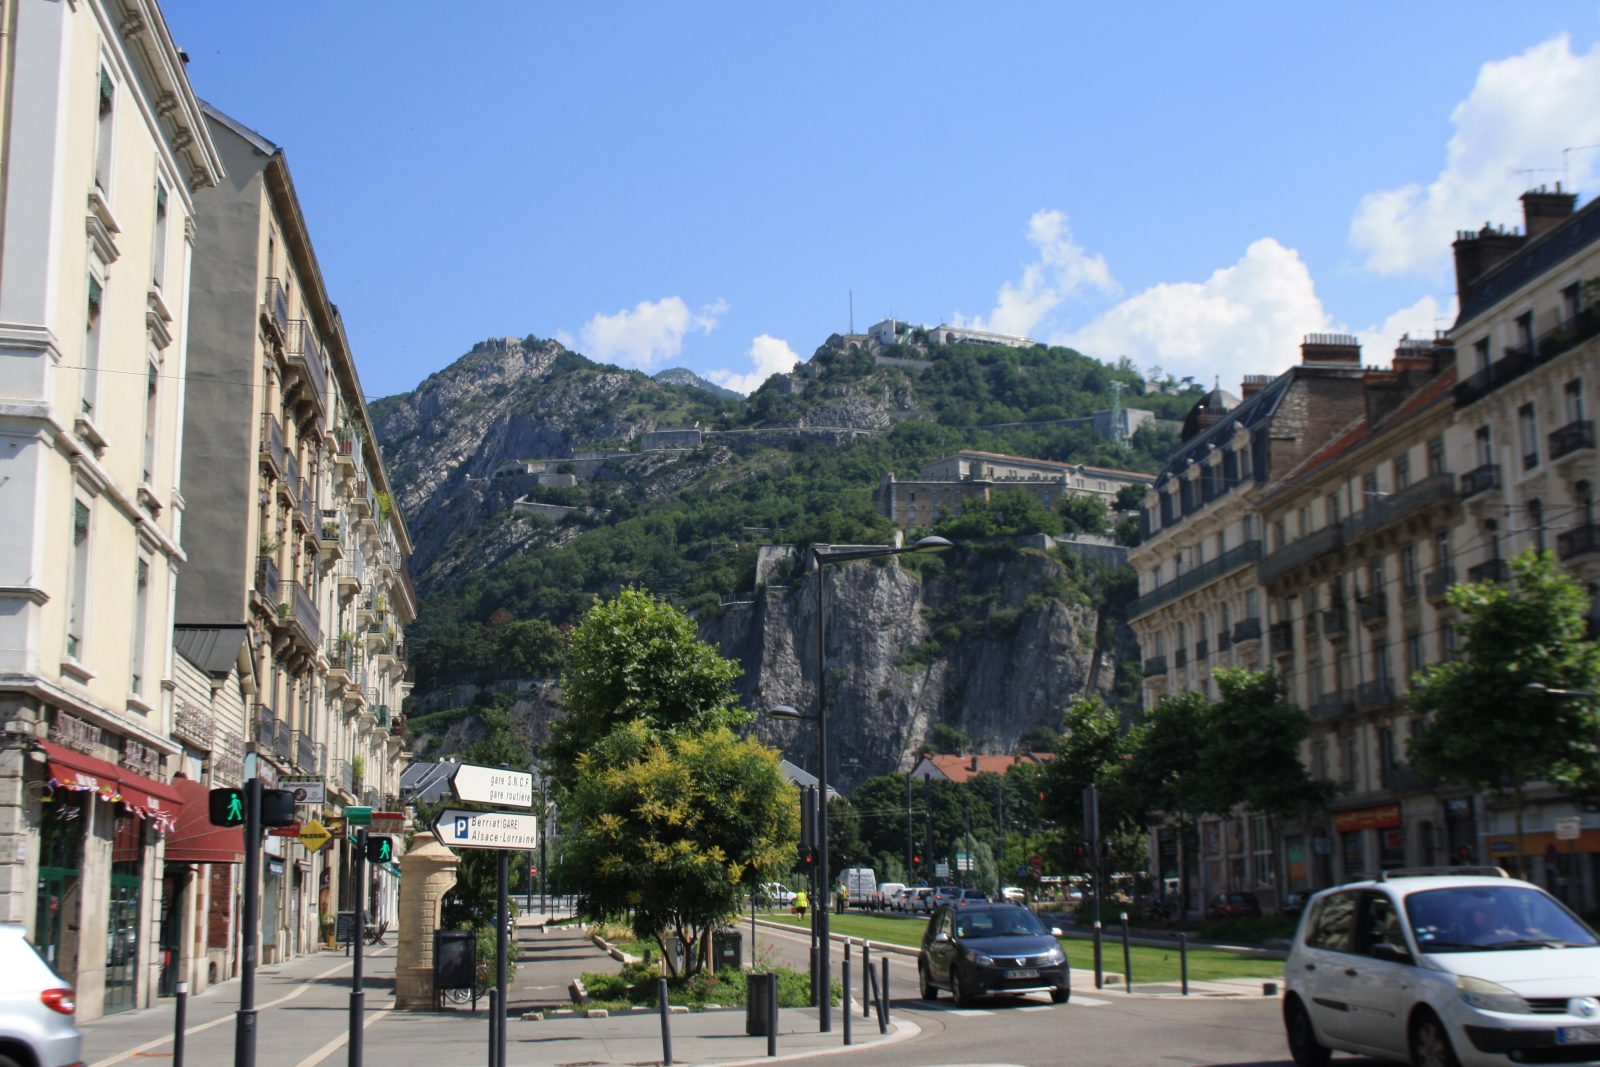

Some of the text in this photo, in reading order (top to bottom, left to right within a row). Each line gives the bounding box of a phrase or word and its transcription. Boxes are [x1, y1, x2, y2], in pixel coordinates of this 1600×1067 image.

[490, 775, 505, 787] gare
[489, 790, 504, 801] gare
[457, 819, 466, 837] P
[471, 816, 500, 828] Berriat
[471, 830, 535, 844] Alsace-Lorraine
